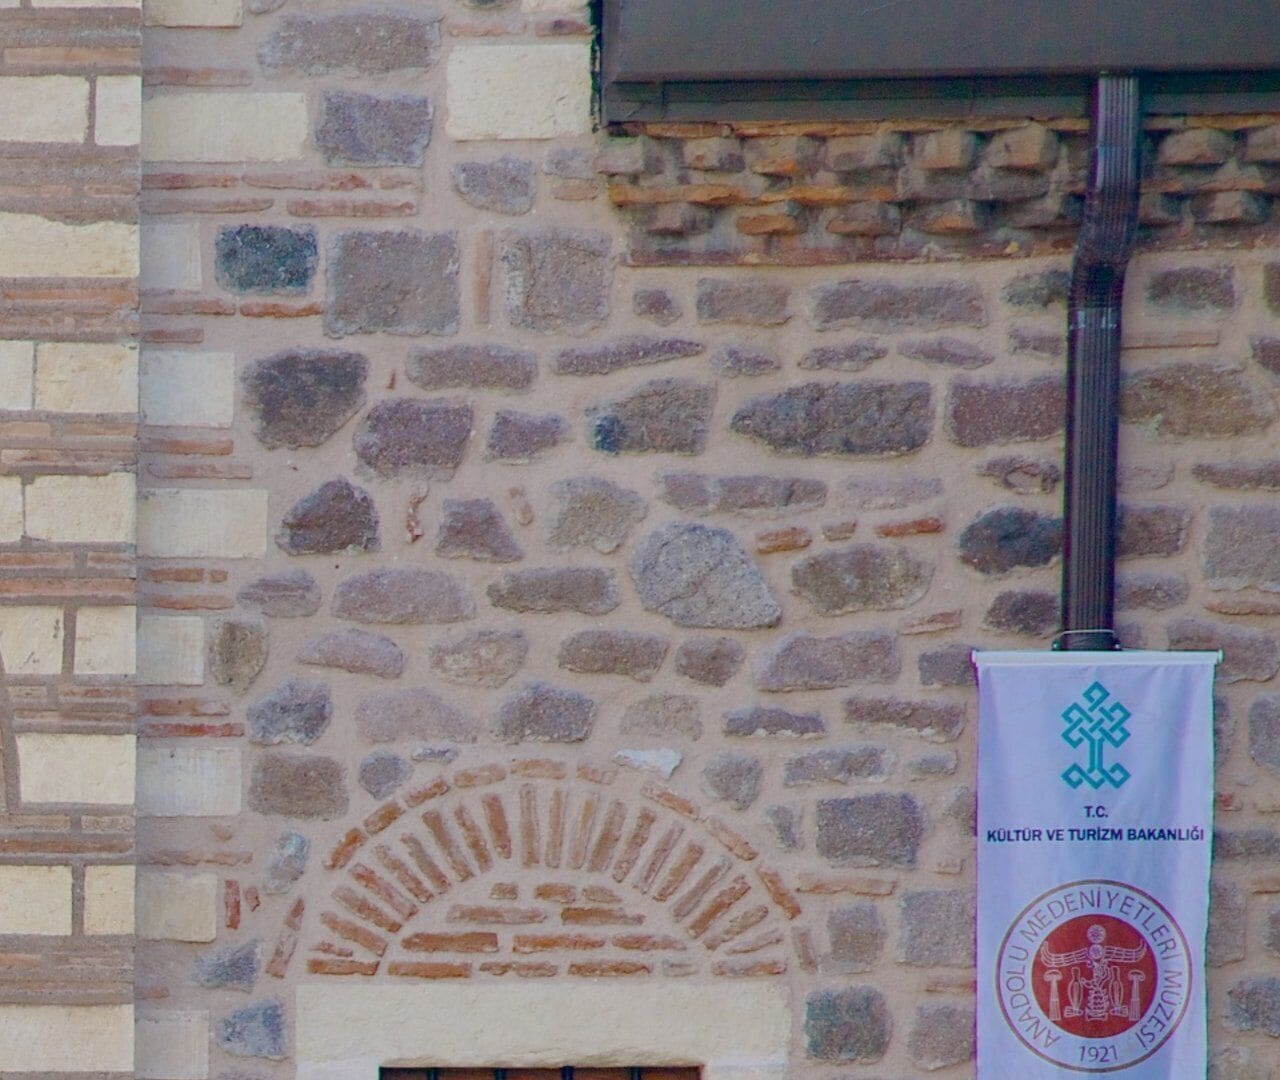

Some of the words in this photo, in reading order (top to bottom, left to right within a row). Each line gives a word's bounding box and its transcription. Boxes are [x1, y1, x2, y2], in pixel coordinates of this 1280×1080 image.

[1083, 805, 1109, 818] T.C.
[986, 827, 1043, 844] KÜLTÜR
[1045, 830, 1067, 842] VE
[1068, 827, 1124, 842] TURİZM
[1126, 827, 1205, 842] BAKANLIĞI
[1020, 888, 1182, 962] MEDENİYETLERİ
[1005, 945, 1058, 1050] ANADOLU
[1136, 968, 1184, 1051] MÜZESİ
[1078, 1044, 1120, 1064] 1921
